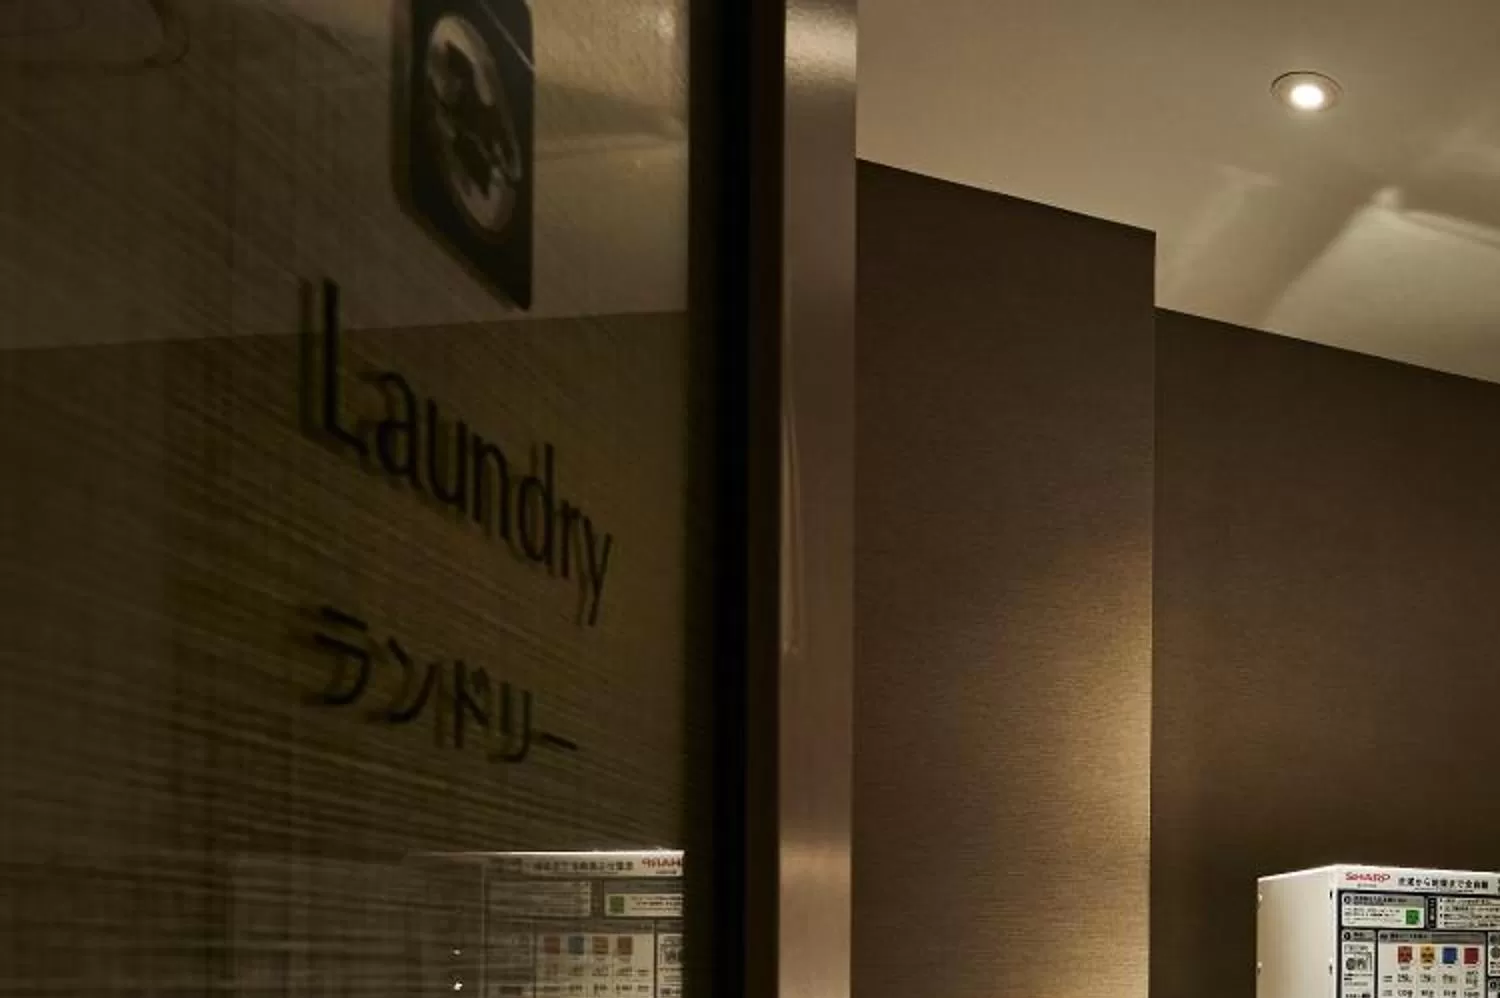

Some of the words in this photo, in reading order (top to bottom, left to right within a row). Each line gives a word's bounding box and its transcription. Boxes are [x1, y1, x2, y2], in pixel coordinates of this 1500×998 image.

[318, 278, 615, 627] Laundry
[312, 606, 579, 763] ランドリー
[1345, 872, 1391, 883] SHARP
